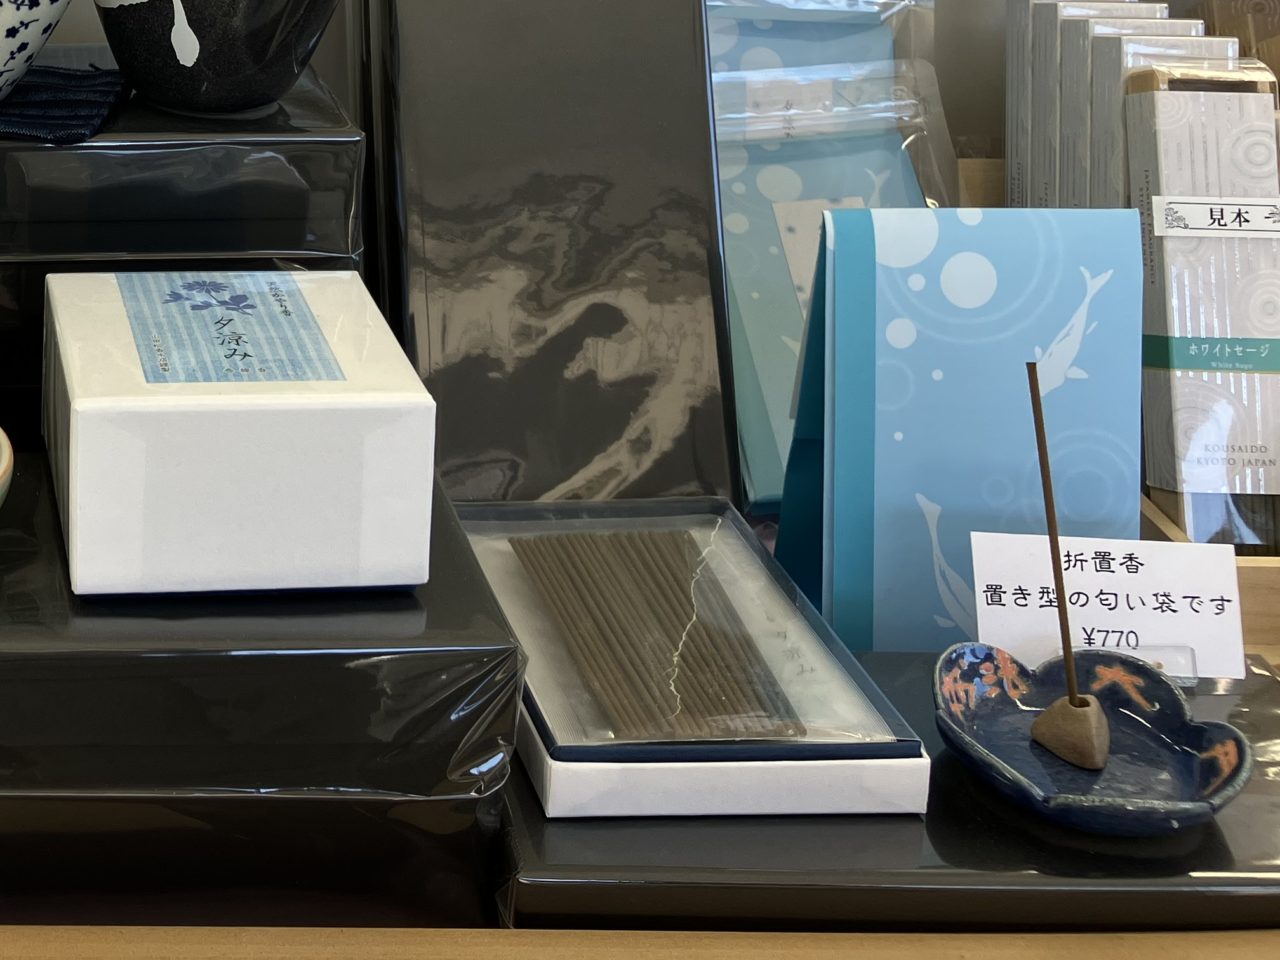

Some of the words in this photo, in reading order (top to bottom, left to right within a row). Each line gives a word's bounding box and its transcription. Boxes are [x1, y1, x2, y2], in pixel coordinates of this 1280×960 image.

[1208, 207, 1251, 228] 見本
[214, 316, 254, 361] 夕涼み
[1189, 343, 1270, 357] ホワイトセージ
[1242, 458, 1276, 467] JAPAN
[1063, 550, 1145, 574] 折置香
[982, 583, 1233, 616] 置き型の匂い袋です
[1082, 626, 1140, 650] ¥770
